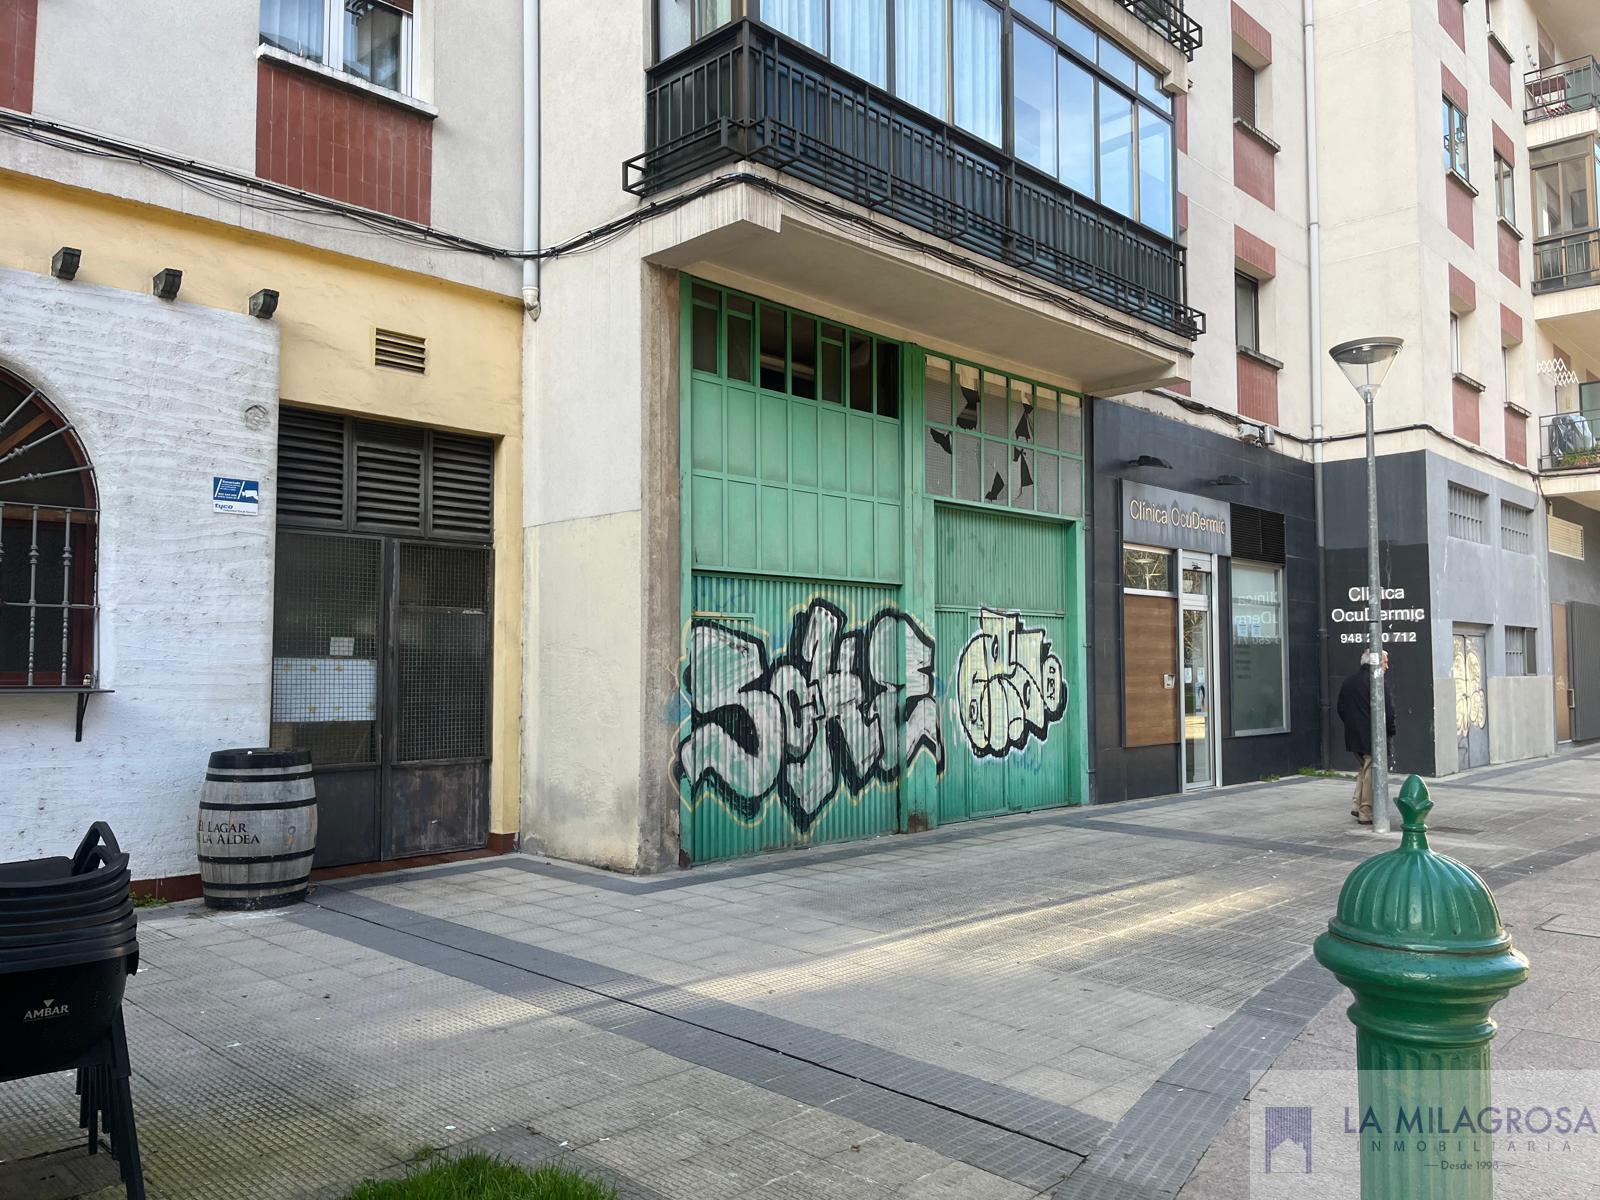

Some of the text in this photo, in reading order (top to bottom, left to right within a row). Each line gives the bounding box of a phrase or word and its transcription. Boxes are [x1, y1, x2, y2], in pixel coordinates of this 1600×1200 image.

[1130, 499, 1226, 535] Clínica OcuDermic
[1340, 633, 1363, 644] 948
[1392, 632, 1417, 643] 712
[207, 820, 248, 833] LAGAR
[216, 834, 260, 845] ALDEA
[23, 1004, 70, 1020] AMBAR
